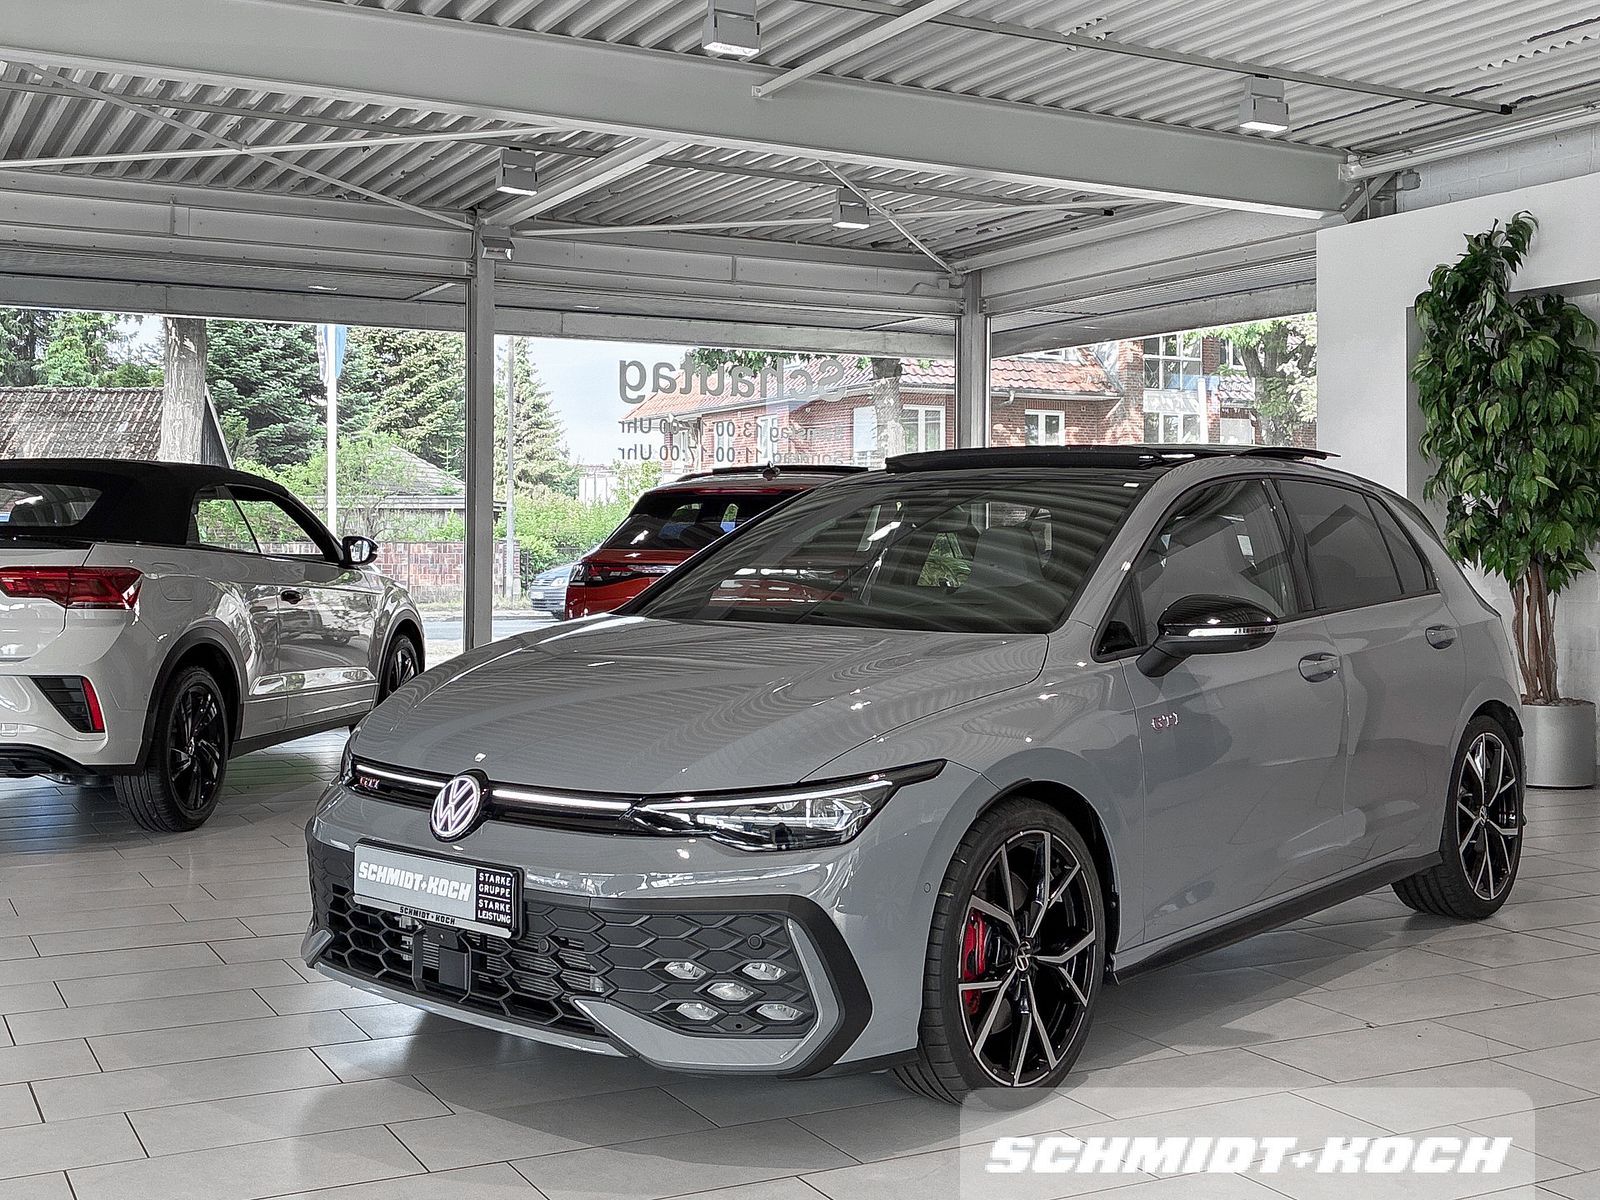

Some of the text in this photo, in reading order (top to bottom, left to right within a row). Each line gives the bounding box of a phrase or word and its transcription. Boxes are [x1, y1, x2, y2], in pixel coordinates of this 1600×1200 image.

[478, 872, 511, 887] STARKE
[478, 883, 511, 898] GRUPPE
[478, 899, 511, 913] STARKE
[478, 910, 512, 925] LEISTUNG
